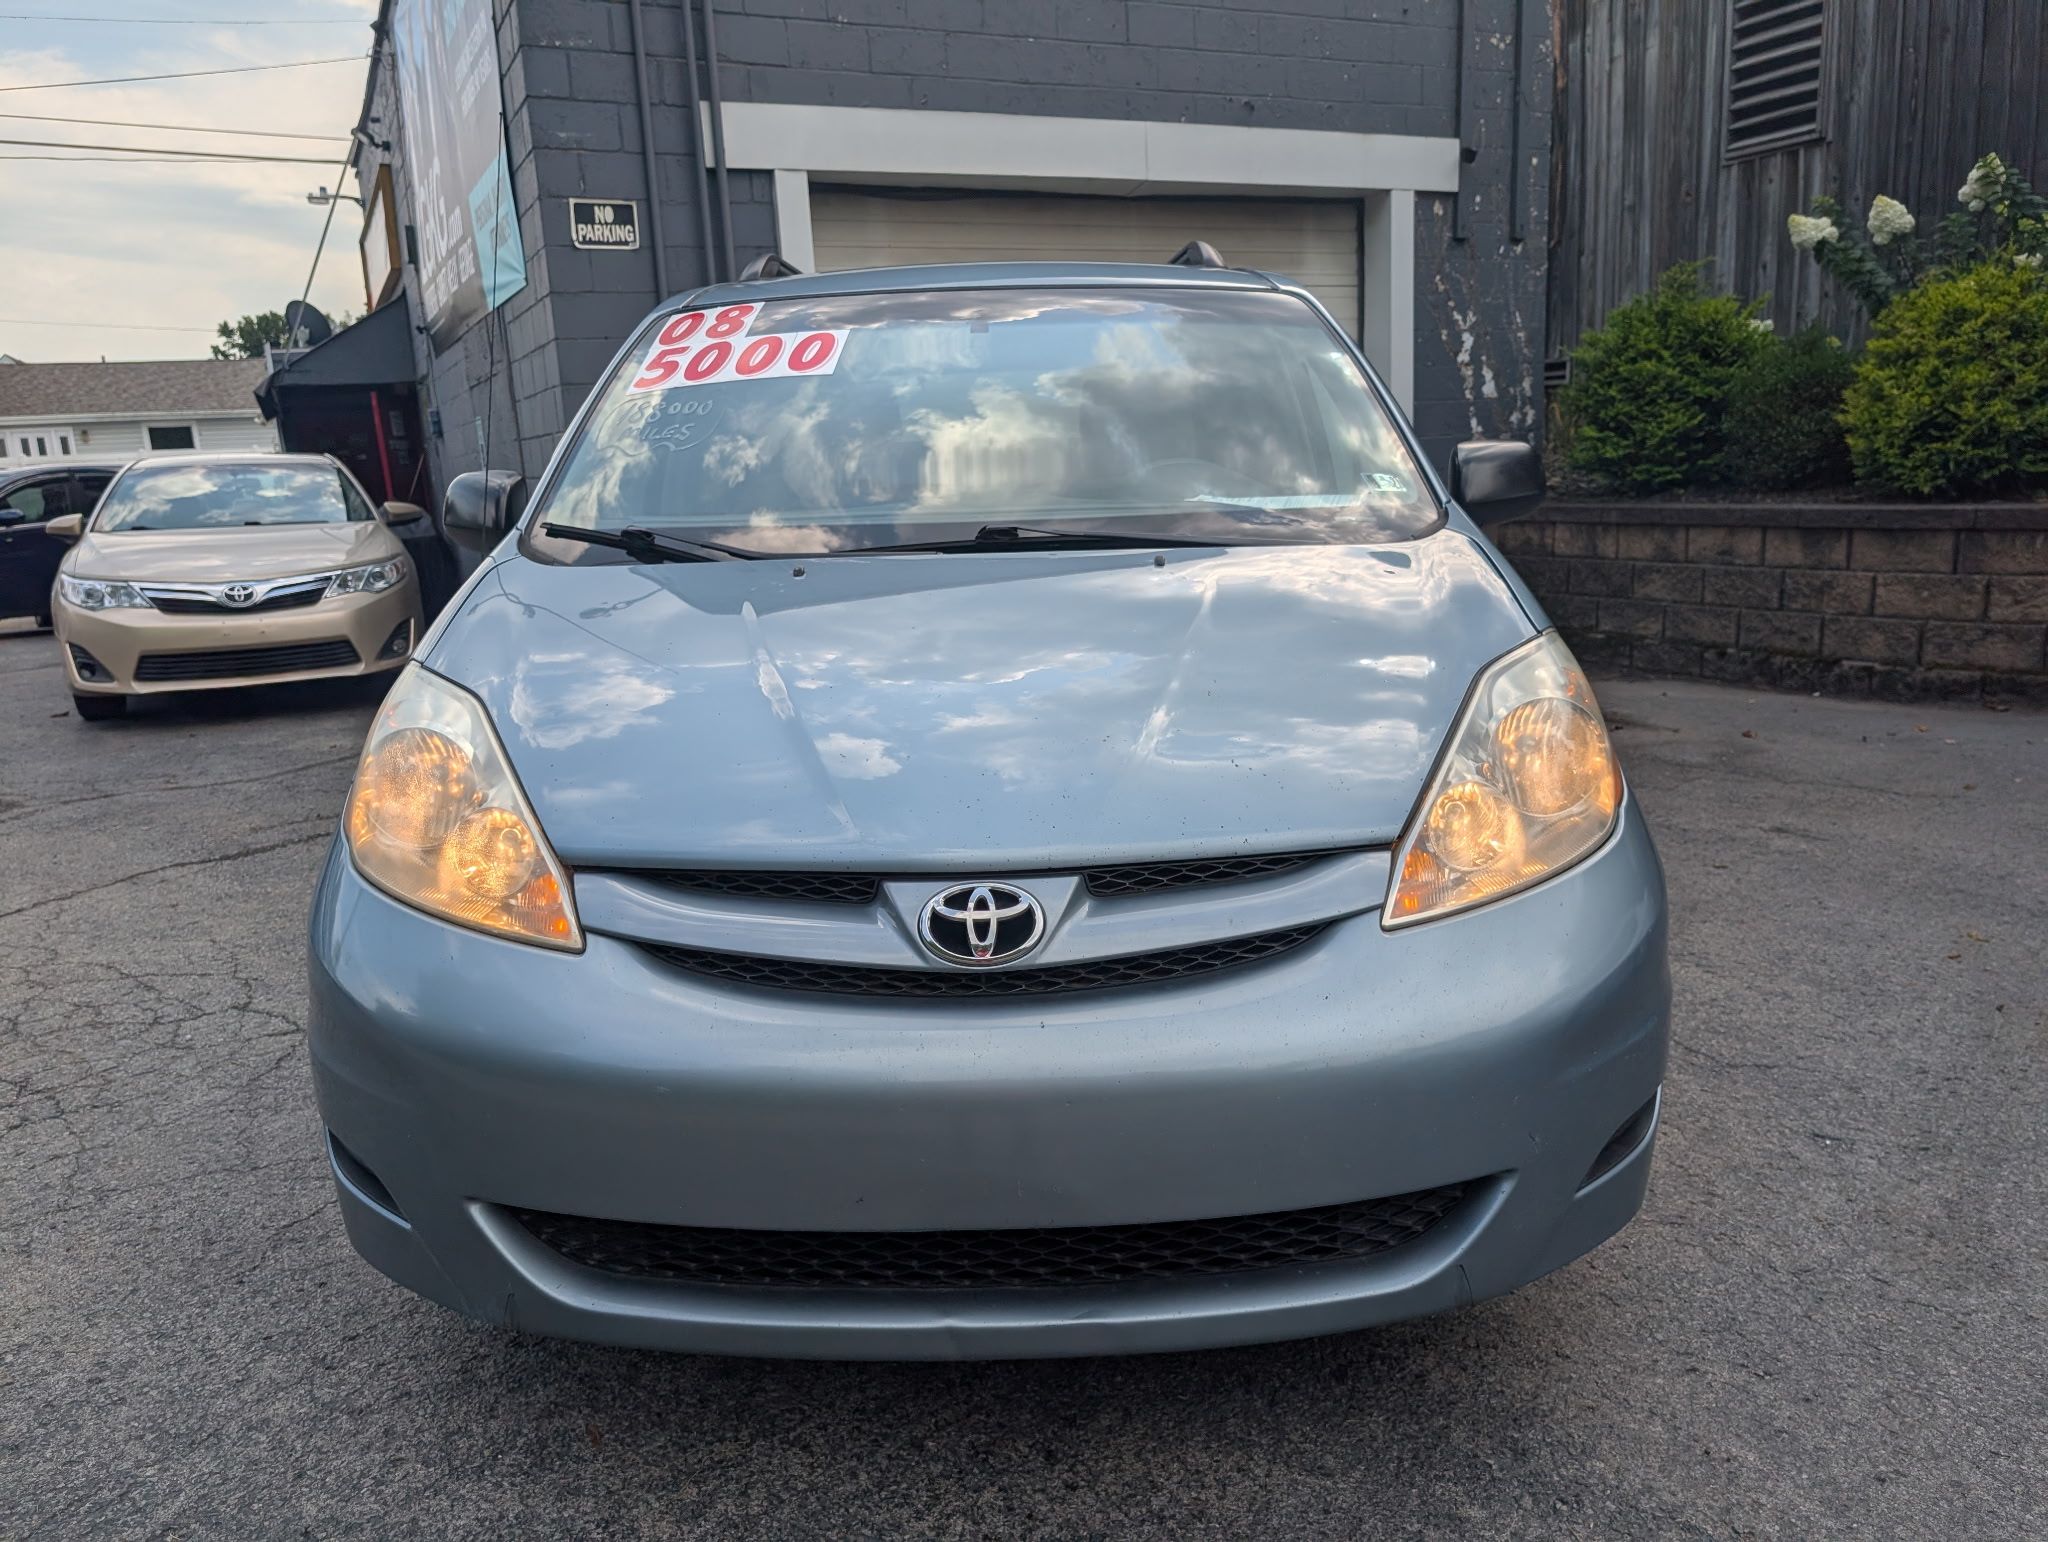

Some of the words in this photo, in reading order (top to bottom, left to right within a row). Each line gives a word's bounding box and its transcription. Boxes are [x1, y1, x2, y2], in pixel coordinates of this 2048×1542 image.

[594, 205, 615, 224] NO
[577, 224, 635, 242] PARKING
[658, 304, 756, 347] 08
[631, 331, 838, 390] 5000
